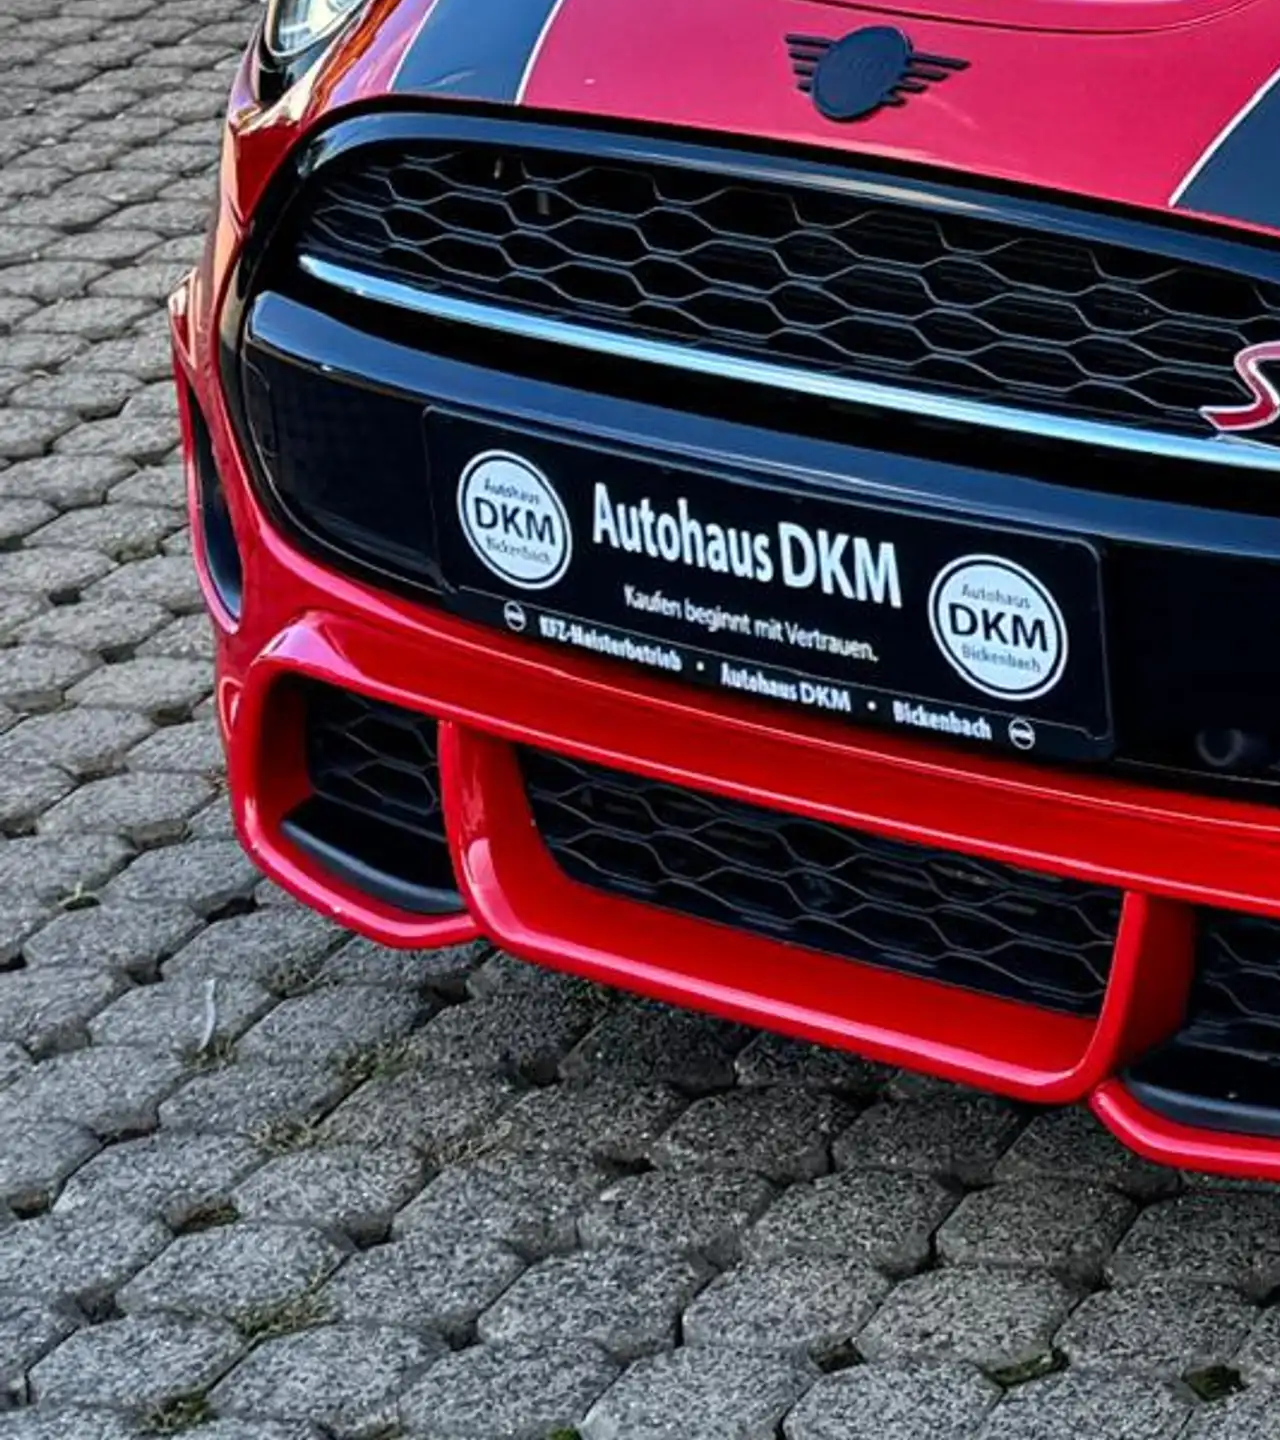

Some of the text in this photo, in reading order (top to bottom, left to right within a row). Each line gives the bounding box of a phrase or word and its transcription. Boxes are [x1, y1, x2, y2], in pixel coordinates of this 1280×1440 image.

[484, 477, 540, 505] Autohaus
[474, 496, 556, 546] DKM
[593, 482, 903, 609] Autohaus DKM
[624, 584, 682, 619] Kaufen
[684, 597, 751, 635] beginnt
[753, 617, 784, 641] mit
[961, 582, 1031, 610] Autohaus
[948, 601, 1049, 653] DKM
[538, 615, 993, 741] KFZ-Meisterbetrieb Autohaus DKM Bickenbach
[961, 644, 1042, 674] Bickenbach
